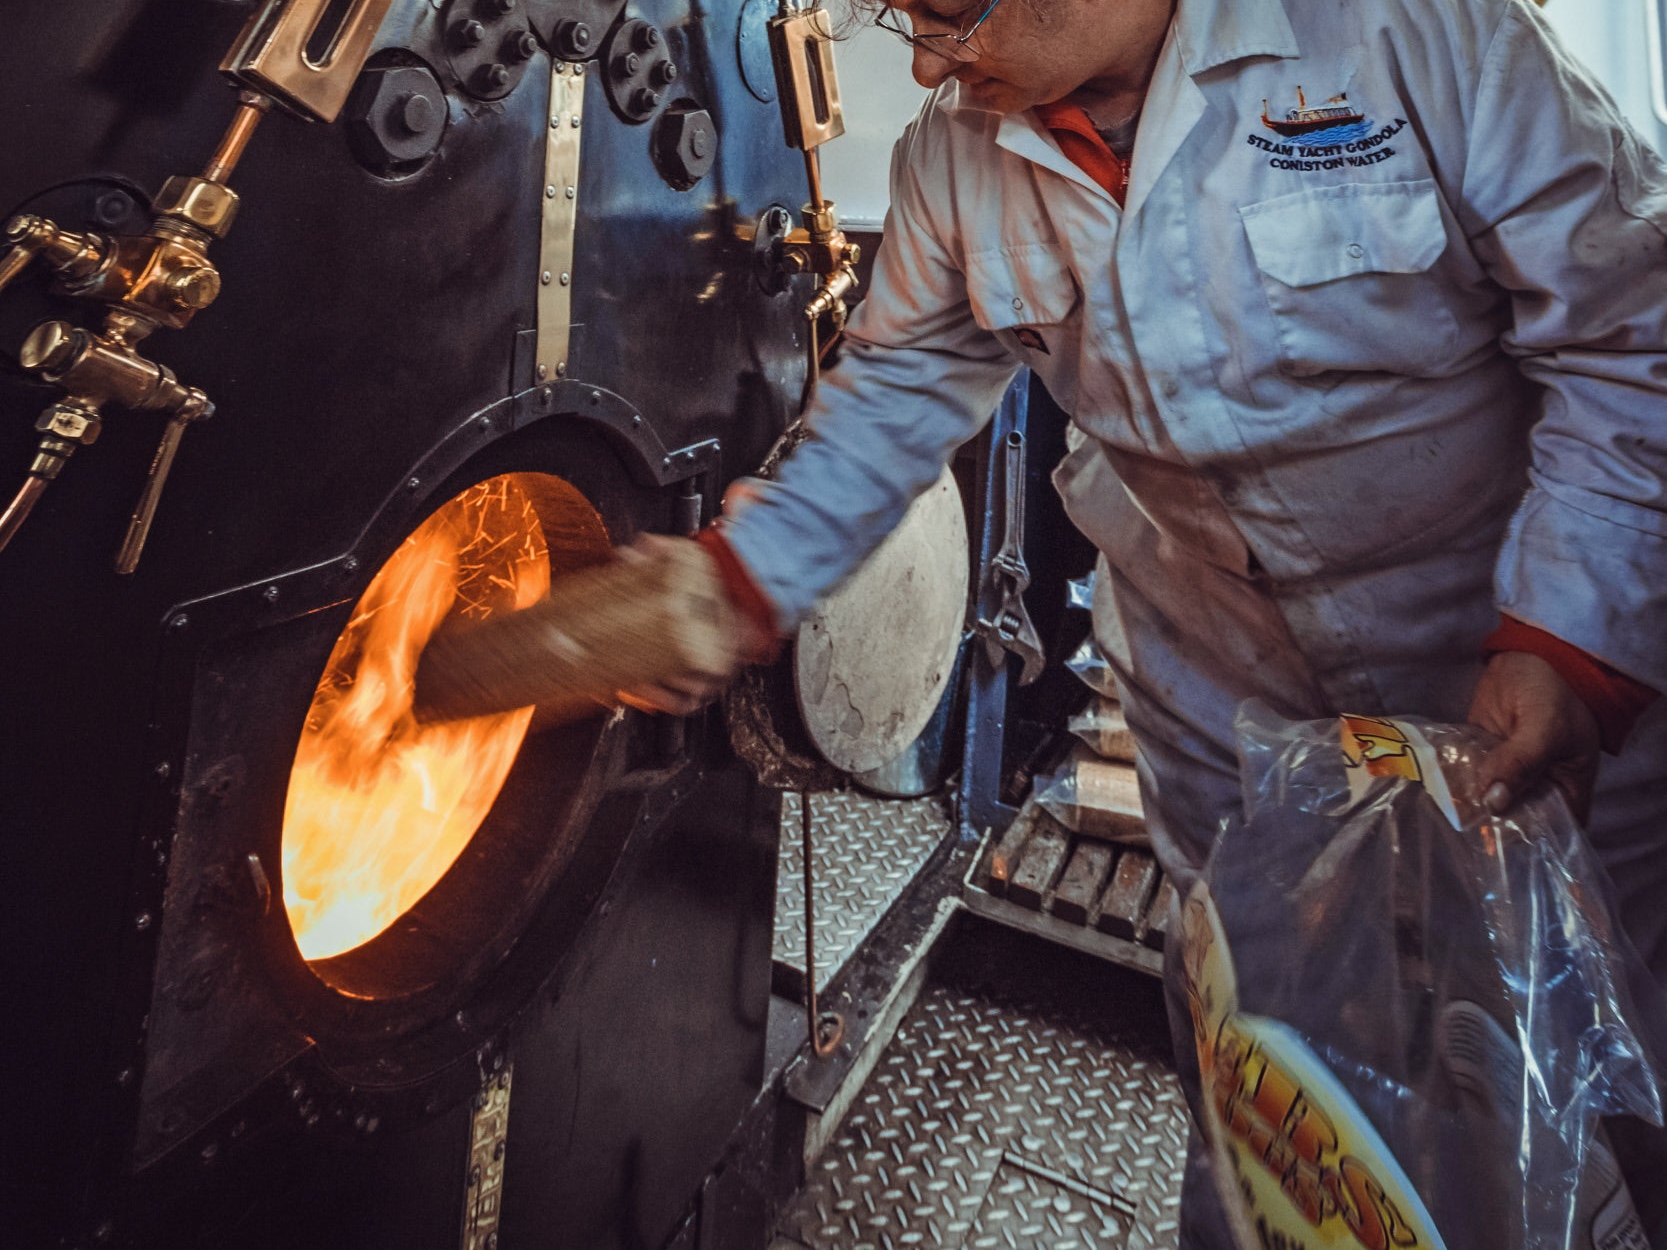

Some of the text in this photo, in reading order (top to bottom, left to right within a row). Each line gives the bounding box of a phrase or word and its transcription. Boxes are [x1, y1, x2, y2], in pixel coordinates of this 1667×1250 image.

[1247, 118, 1408, 158] STEAM YACHT GONDOLA
[1269, 146, 1396, 172] CONISTON WATER
